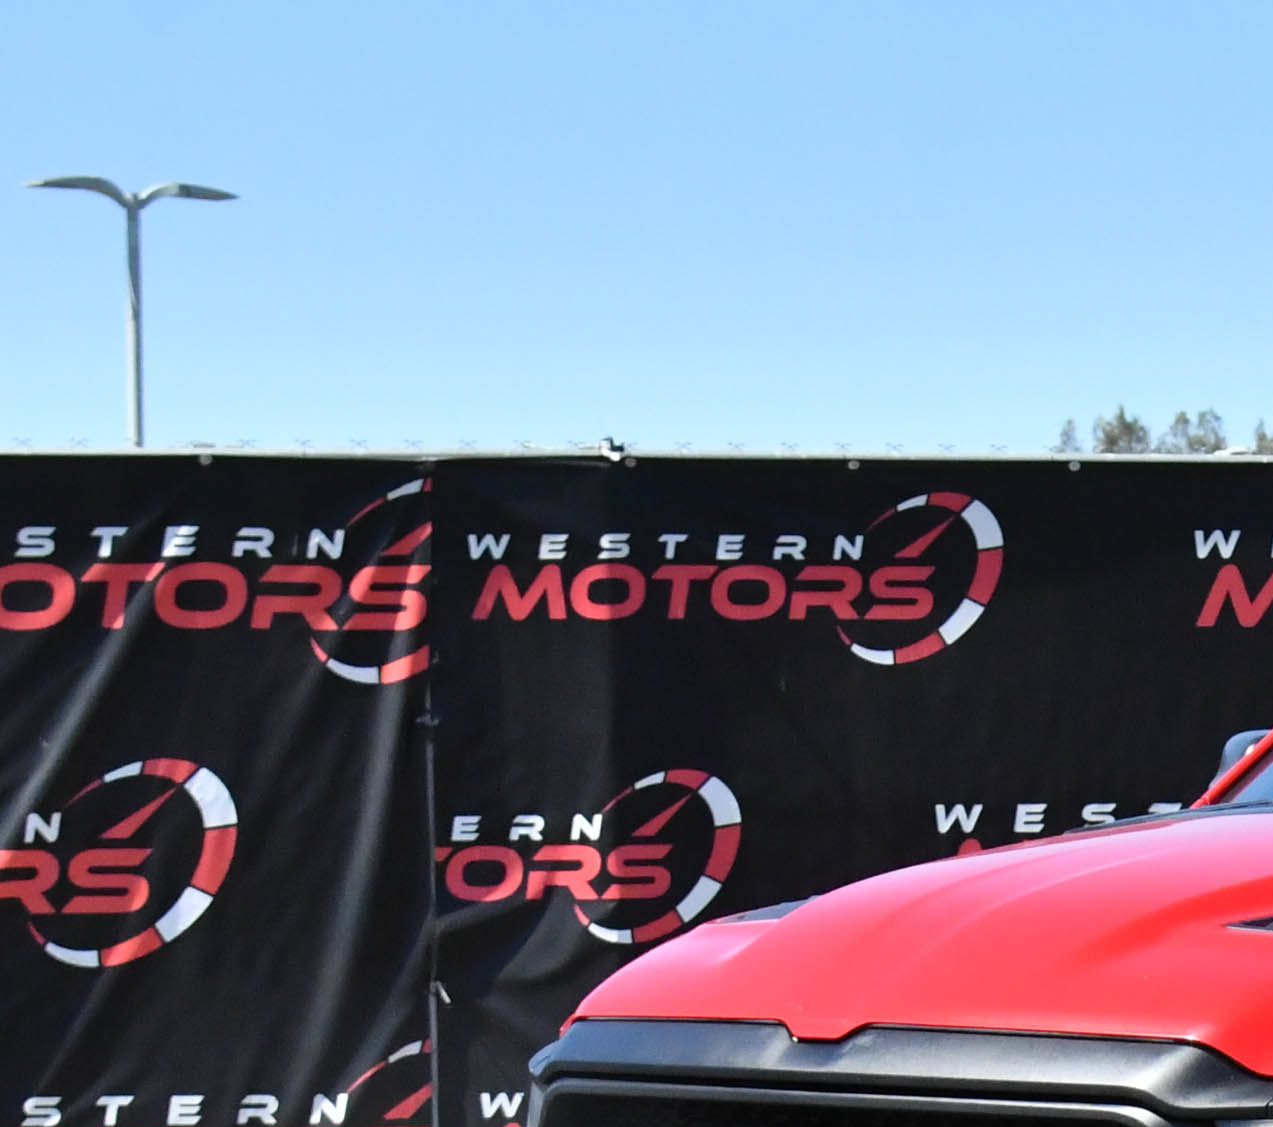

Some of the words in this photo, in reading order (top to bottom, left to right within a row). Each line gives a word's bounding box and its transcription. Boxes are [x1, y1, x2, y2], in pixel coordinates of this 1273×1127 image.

[467, 533, 864, 560] WESTERN
[472, 564, 935, 620] MOTORS
[434, 844, 674, 902] ORS
